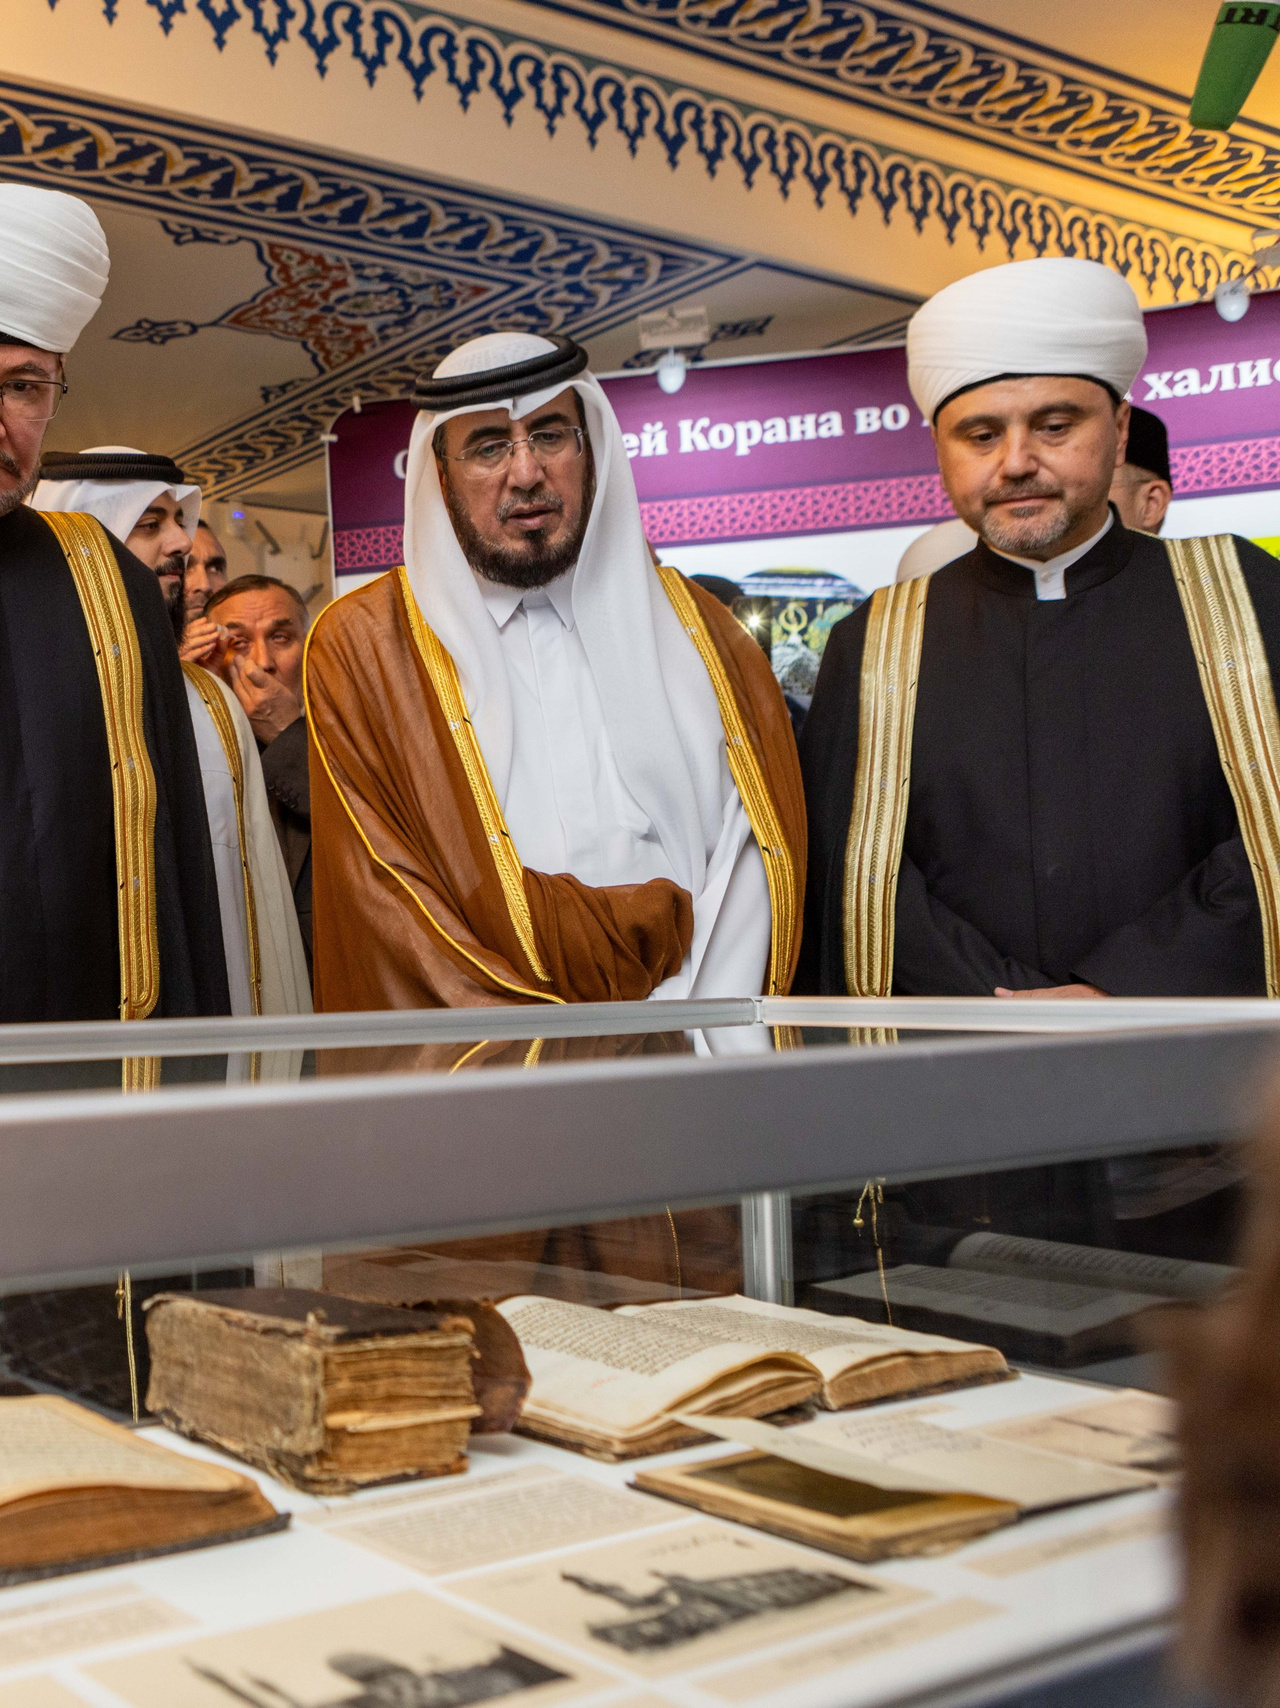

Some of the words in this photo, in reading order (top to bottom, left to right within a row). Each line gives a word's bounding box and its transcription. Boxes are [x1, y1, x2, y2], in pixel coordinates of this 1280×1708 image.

[621, 421, 669, 459] ей
[678, 410, 844, 457] Корана
[854, 403, 910, 435] во
[1142, 357, 1280, 402] хали
